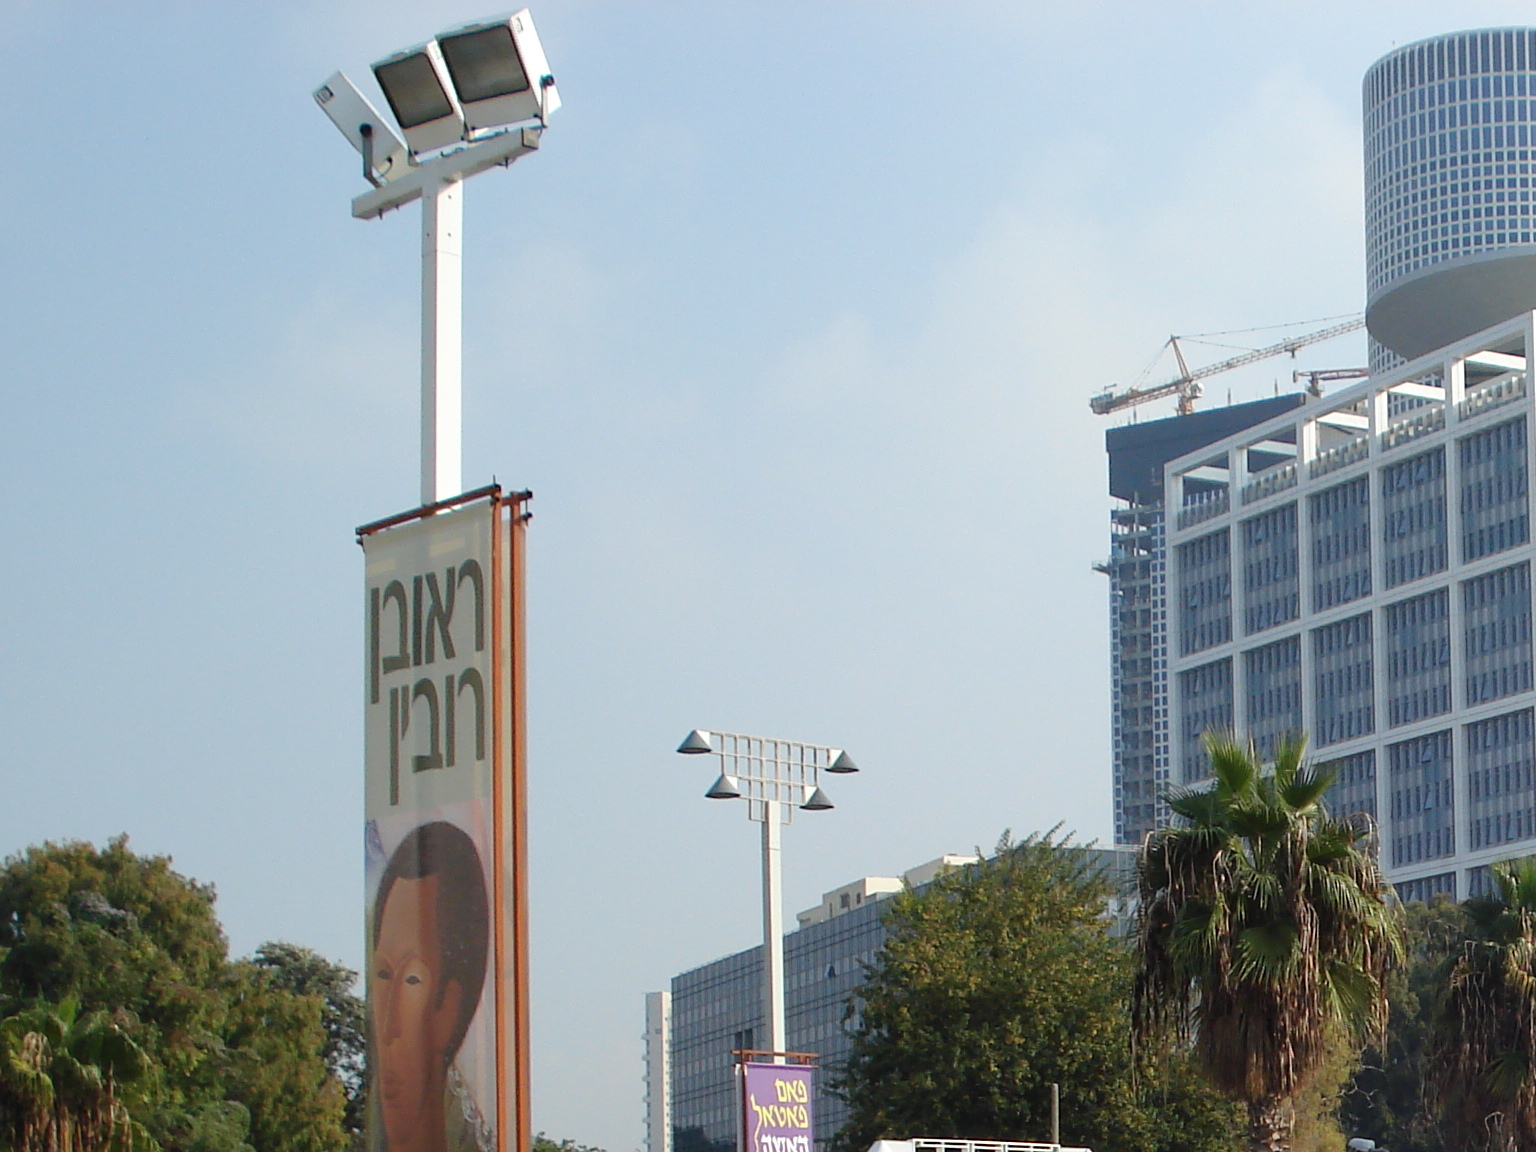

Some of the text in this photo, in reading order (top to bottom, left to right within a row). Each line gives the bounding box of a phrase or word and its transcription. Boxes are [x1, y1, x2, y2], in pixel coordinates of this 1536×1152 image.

[370, 557, 485, 705] ראובן
[388, 666, 486, 806] רובין
[751, 1093, 809, 1152] פאטאל
[774, 1078, 808, 1104] פאם
